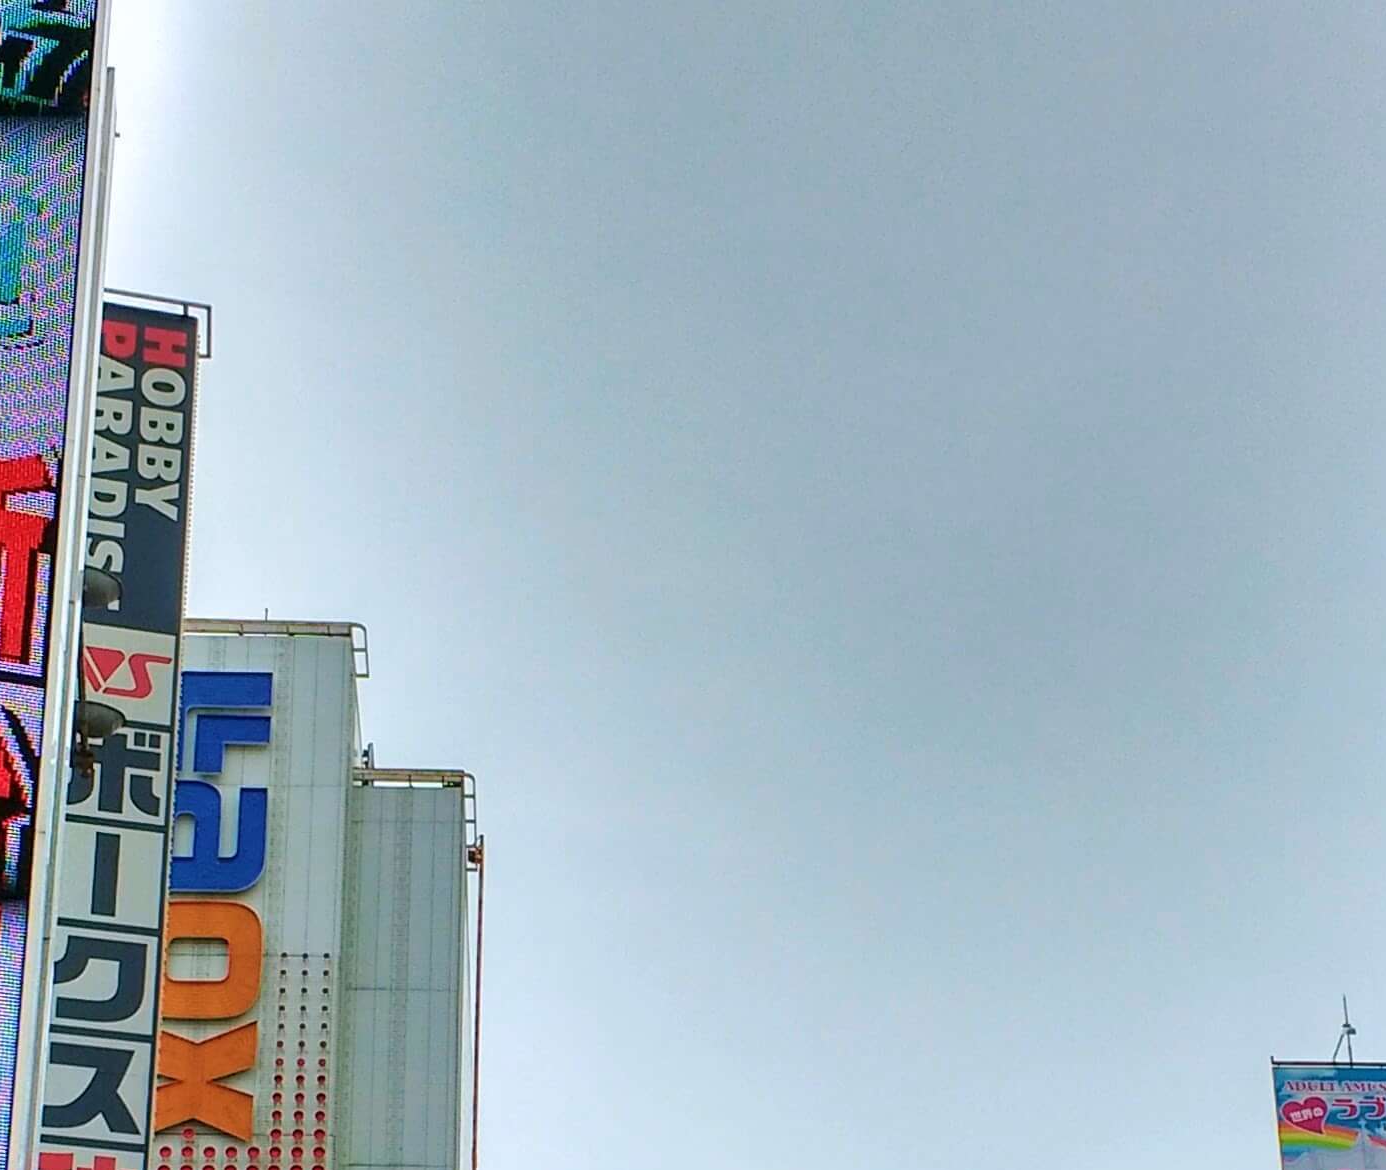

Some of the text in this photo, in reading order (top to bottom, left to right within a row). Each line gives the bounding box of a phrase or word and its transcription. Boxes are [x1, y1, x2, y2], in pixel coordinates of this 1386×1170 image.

[84, 319, 138, 614] PARADIS
[135, 327, 187, 521] HOBBY
[1284, 1079, 1336, 1093] ADULT
